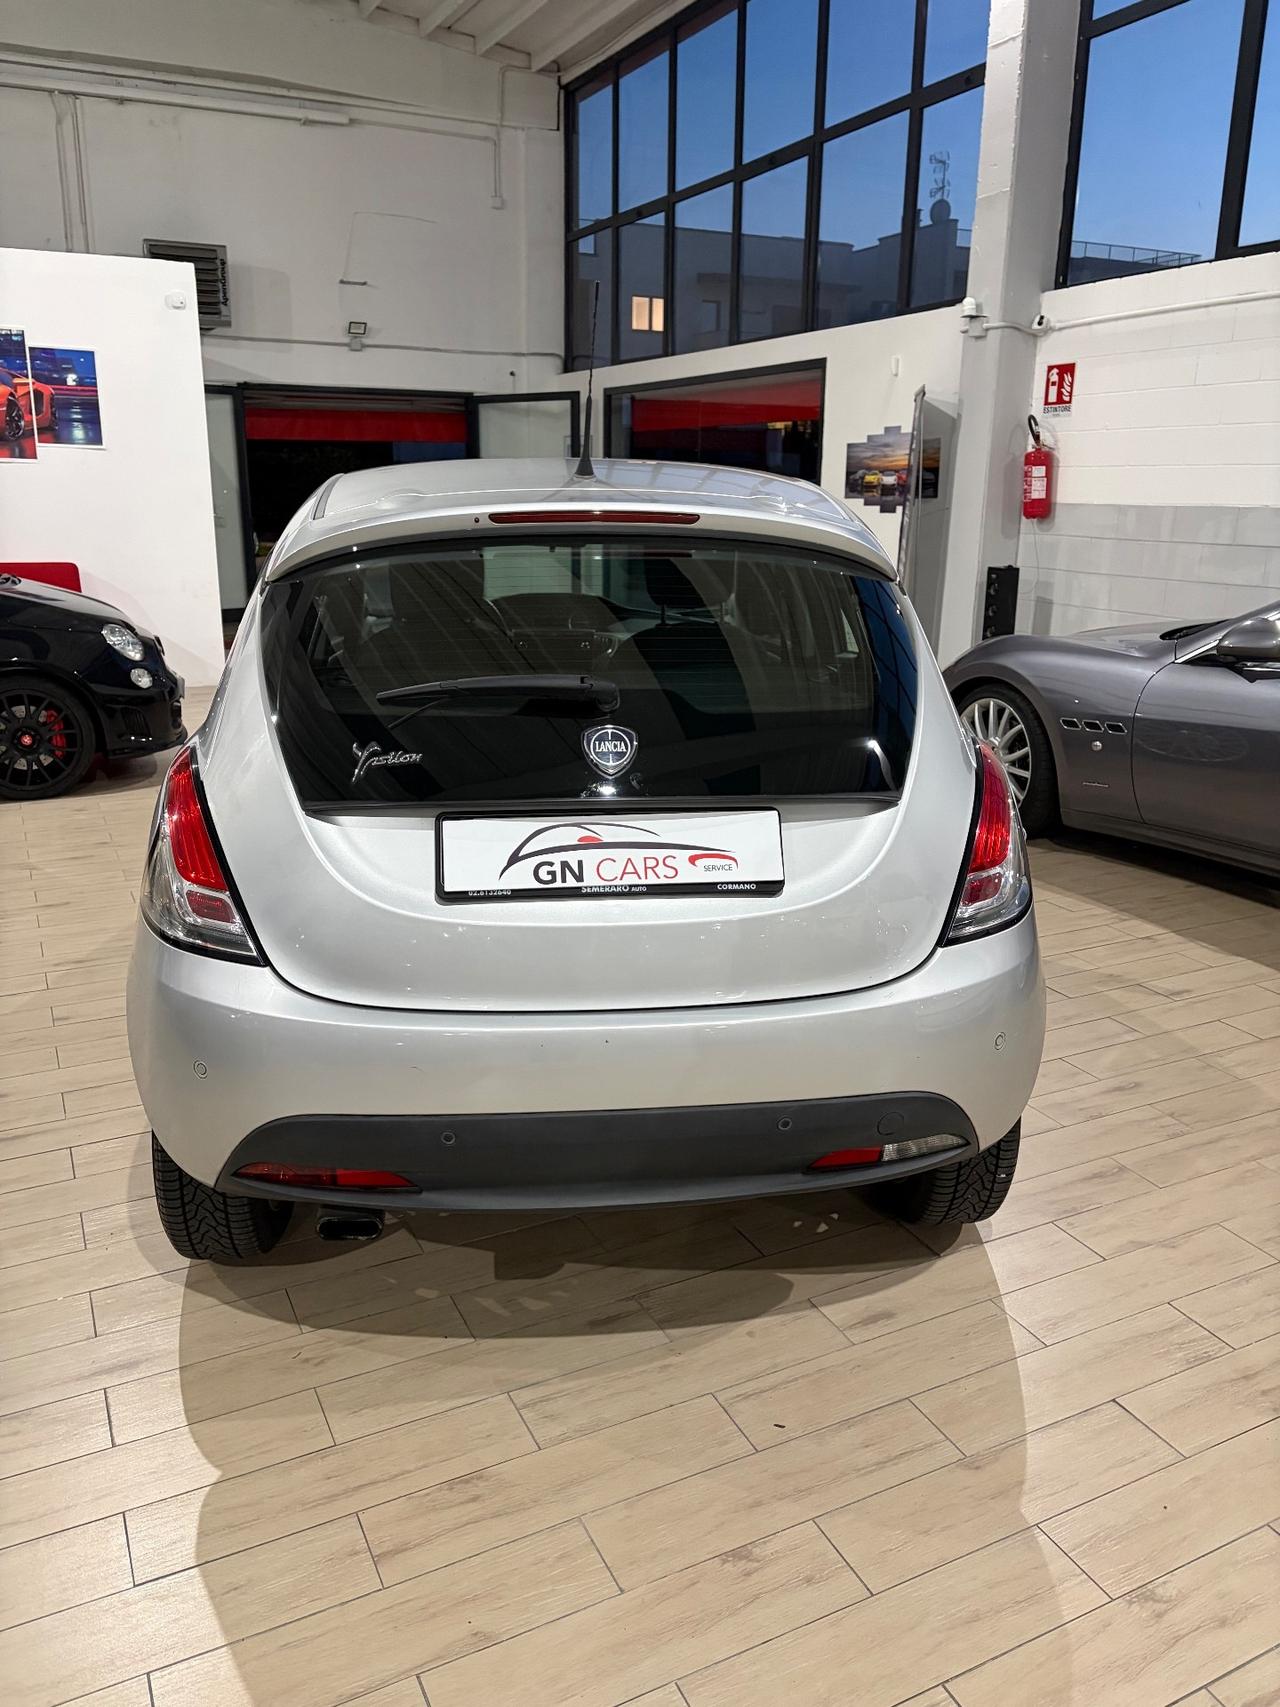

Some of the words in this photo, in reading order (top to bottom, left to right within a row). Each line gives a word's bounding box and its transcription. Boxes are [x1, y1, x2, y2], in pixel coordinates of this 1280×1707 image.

[1043, 405, 1071, 414] ESTINTORE
[595, 741, 627, 752] LANCIA
[533, 859, 585, 885] GN
[596, 855, 679, 882] CARS
[703, 863, 733, 872] SERVICE
[581, 884, 630, 893] SEMERARO
